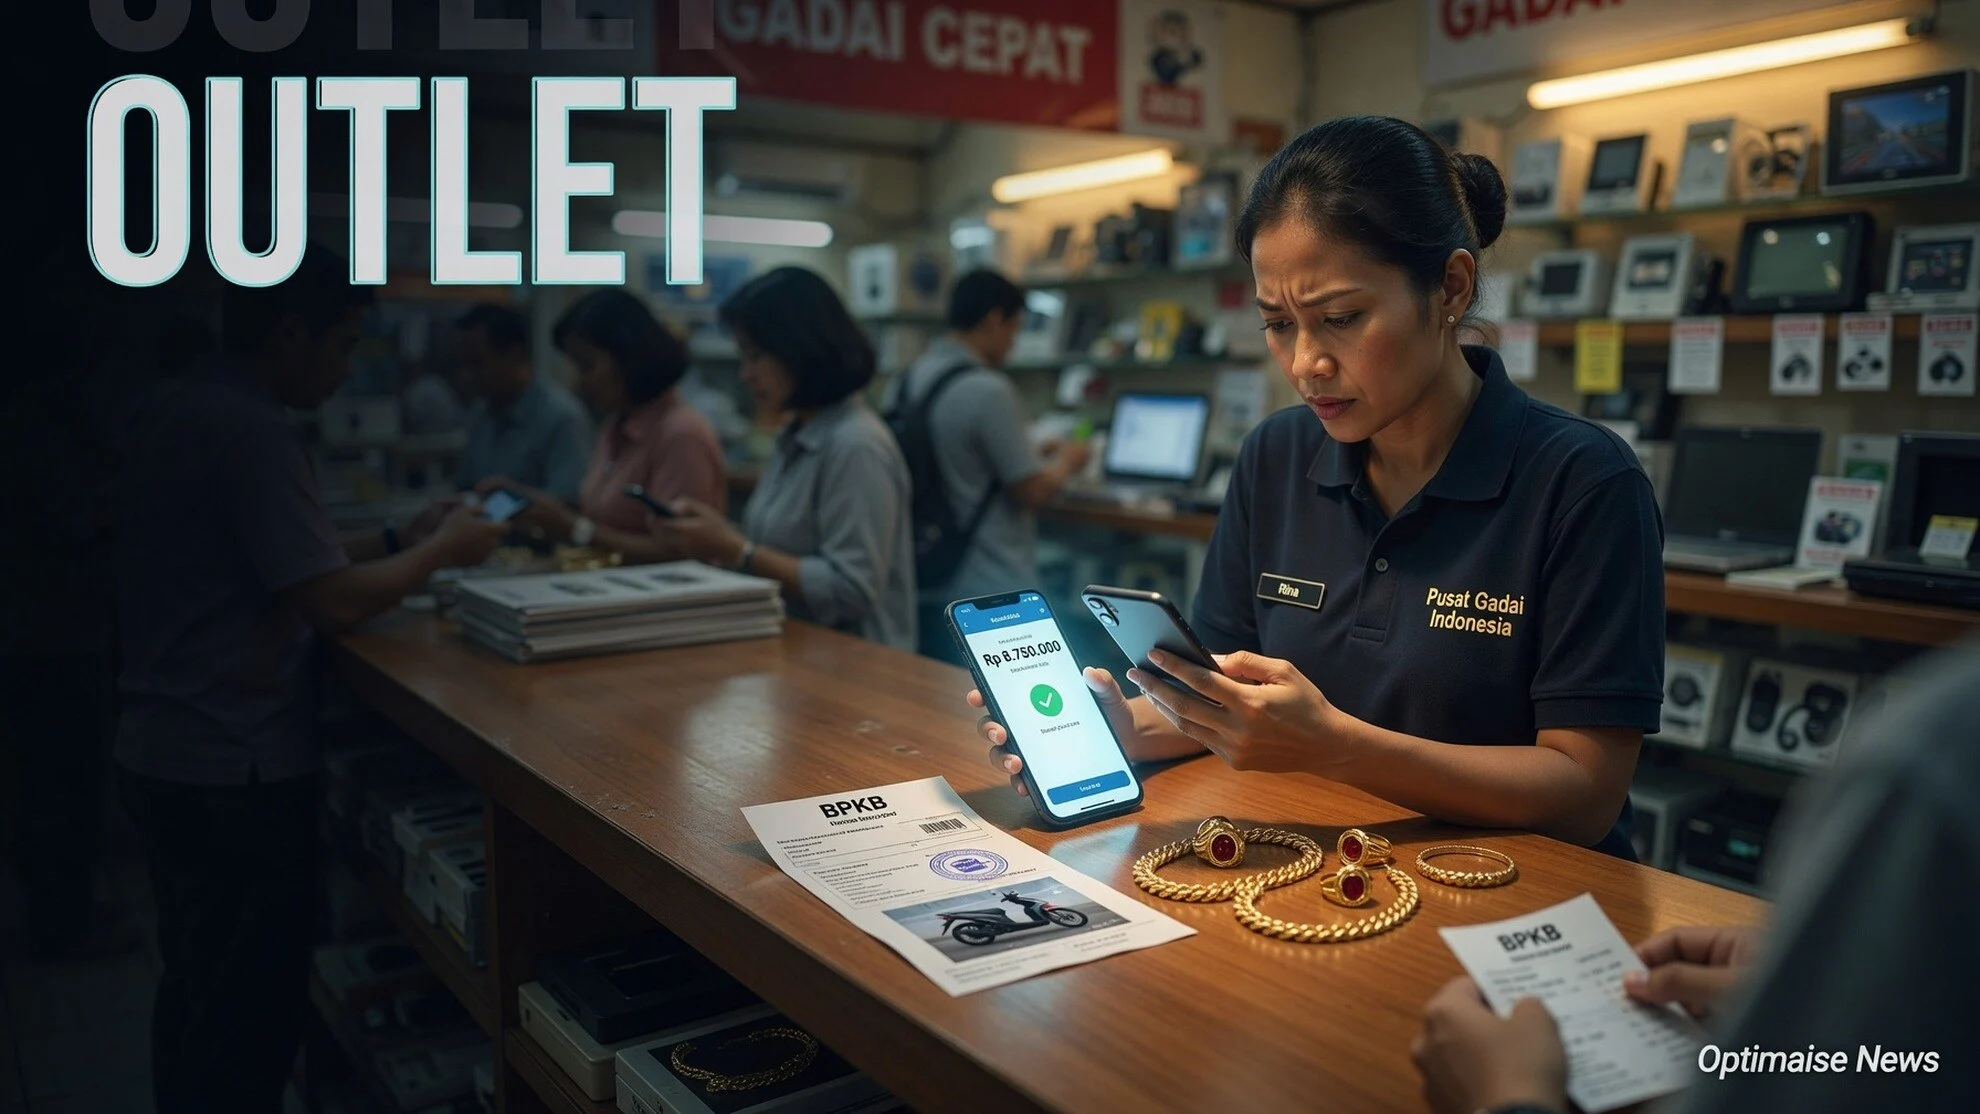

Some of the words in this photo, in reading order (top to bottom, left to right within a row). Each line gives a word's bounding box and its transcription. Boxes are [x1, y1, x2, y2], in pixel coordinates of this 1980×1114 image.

[715, 0, 906, 62] GADAI
[920, 5, 1092, 85] CEPAT
[1426, 587, 1469, 608] Pusat
[1474, 591, 1525, 615] Gadai
[1429, 609, 1512, 637] Indonesia
[983, 653, 1001, 668] Rp
[818, 795, 888, 819] BPKB
[1497, 923, 1563, 952] BPKB
